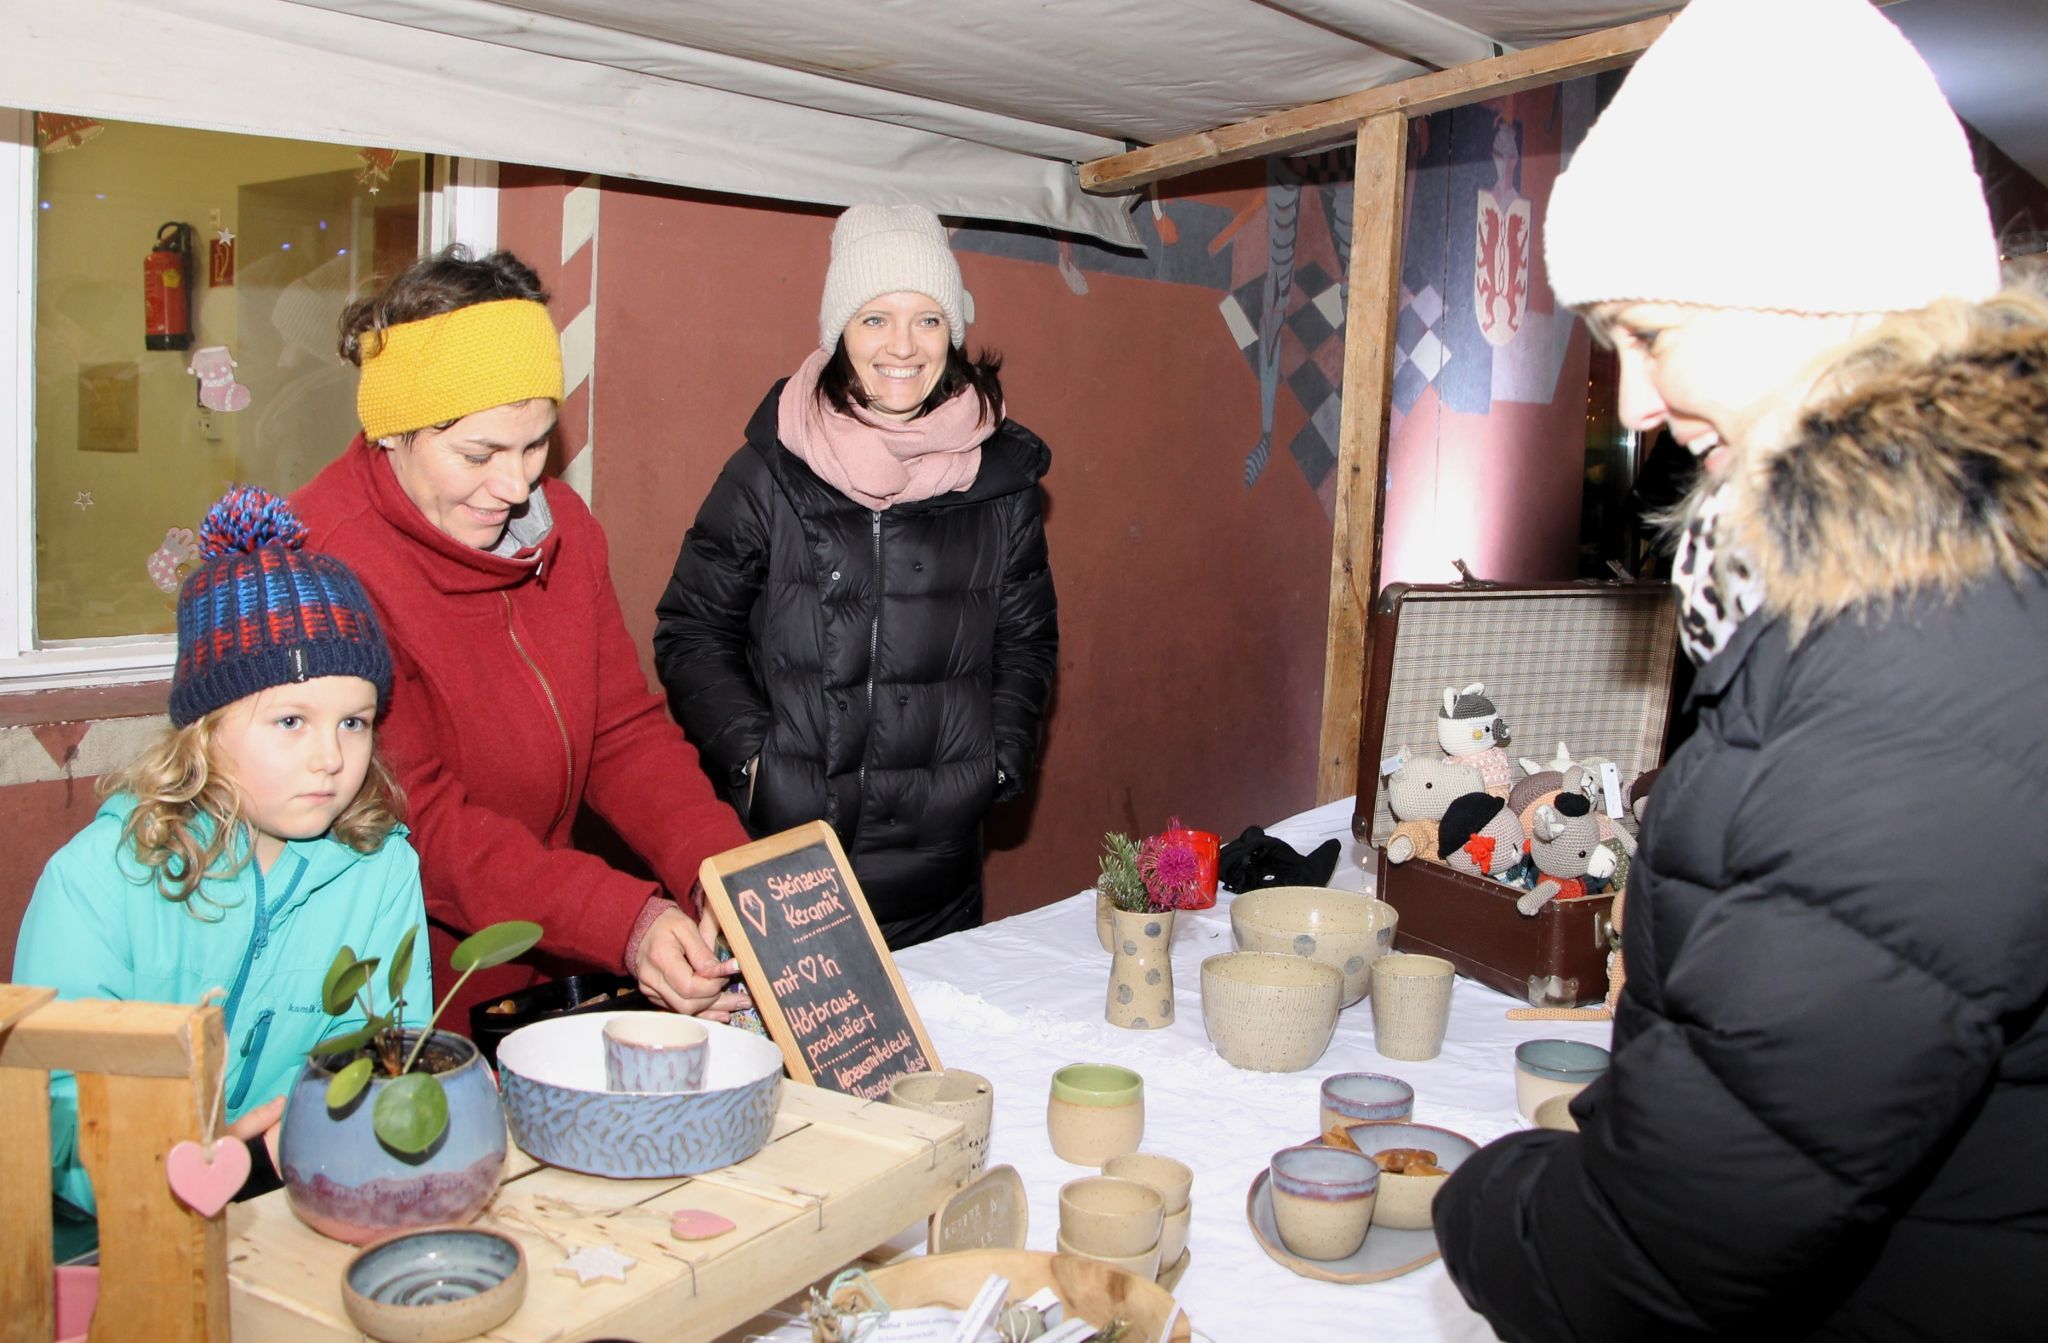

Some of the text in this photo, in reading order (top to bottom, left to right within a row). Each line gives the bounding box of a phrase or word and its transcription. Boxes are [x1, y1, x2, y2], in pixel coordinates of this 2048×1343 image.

[767, 868, 839, 900] Steinzeug-
[782, 890, 845, 928] Keramik
[772, 953, 842, 998] mit in
[807, 1004, 877, 1075] produziert
